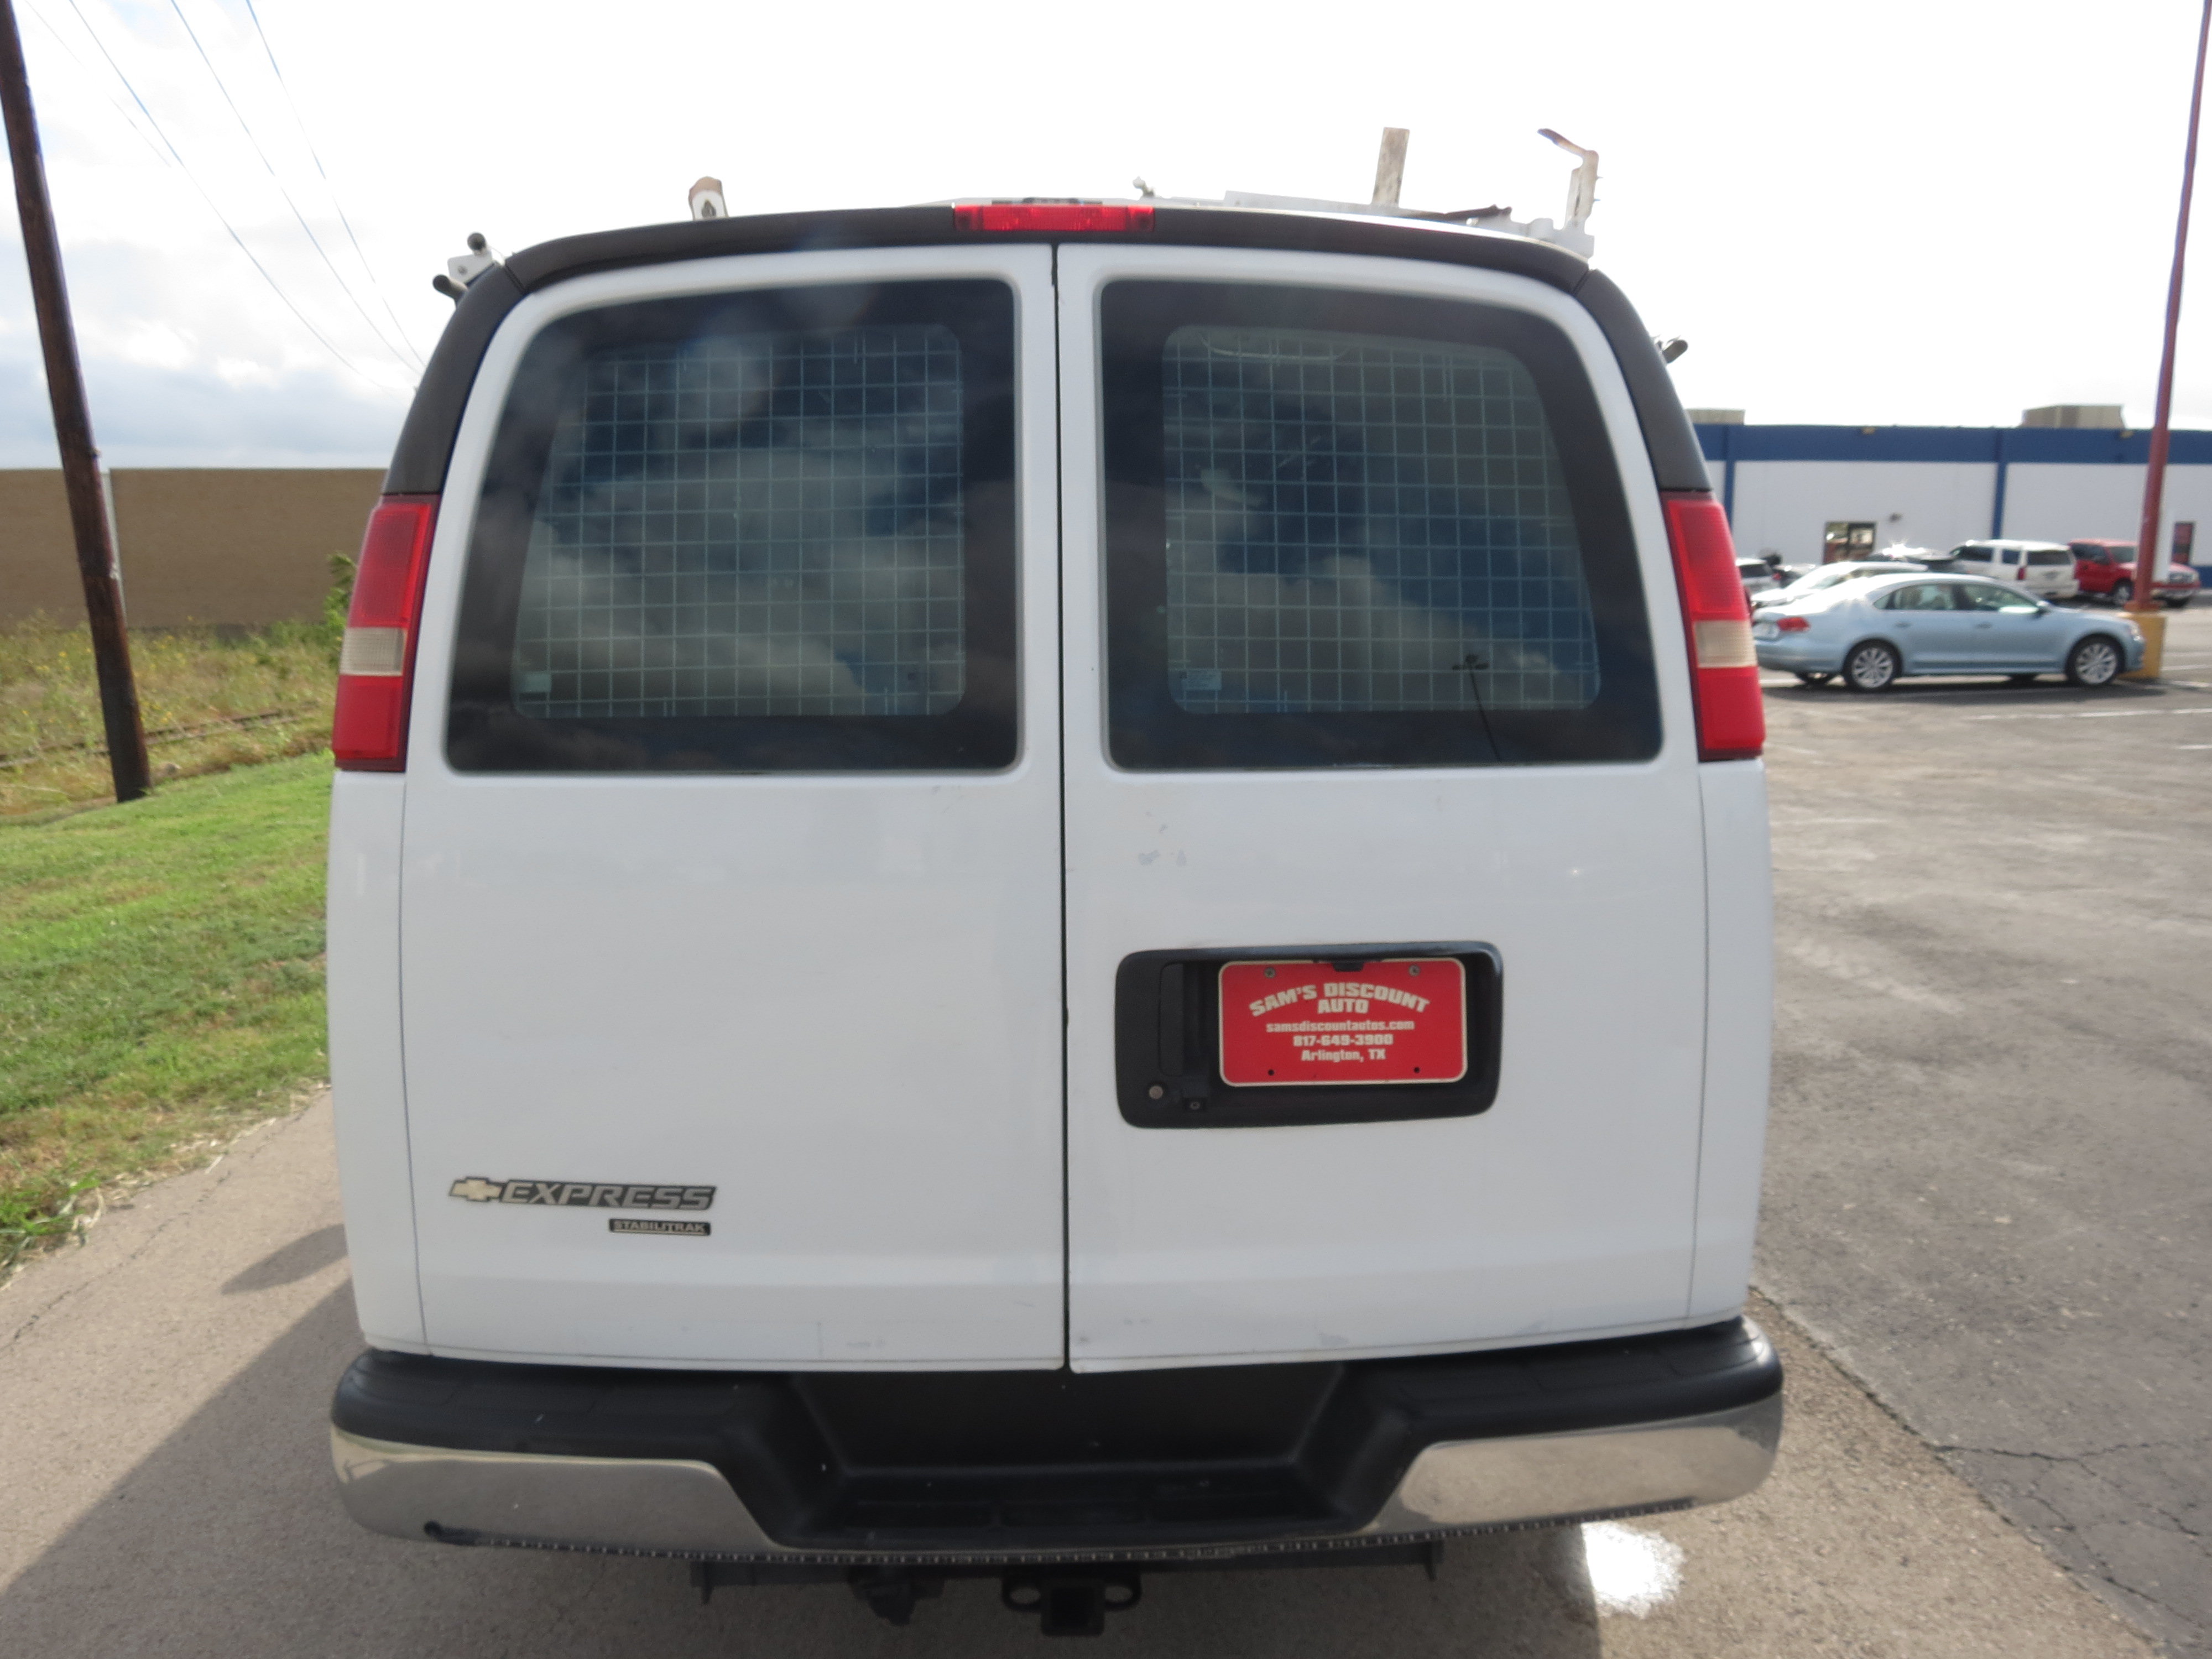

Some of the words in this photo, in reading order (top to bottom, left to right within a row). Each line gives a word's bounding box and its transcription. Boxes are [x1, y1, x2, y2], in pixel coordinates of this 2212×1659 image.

[1249, 984, 1317, 1017] SAM'S
[1323, 982, 1430, 1013] DISCOUNT
[1317, 999, 1369, 1014] AUTO
[1266, 1020, 1415, 1032] samsdiscountautos.com
[1293, 1034, 1394, 1047] 817-649-3900
[1301, 1050, 1364, 1063] Arlington,
[1368, 1048, 1386, 1060] TX
[499, 1181, 714, 1209] EXPRESS
[613, 1220, 706, 1233] STABILITRAK
